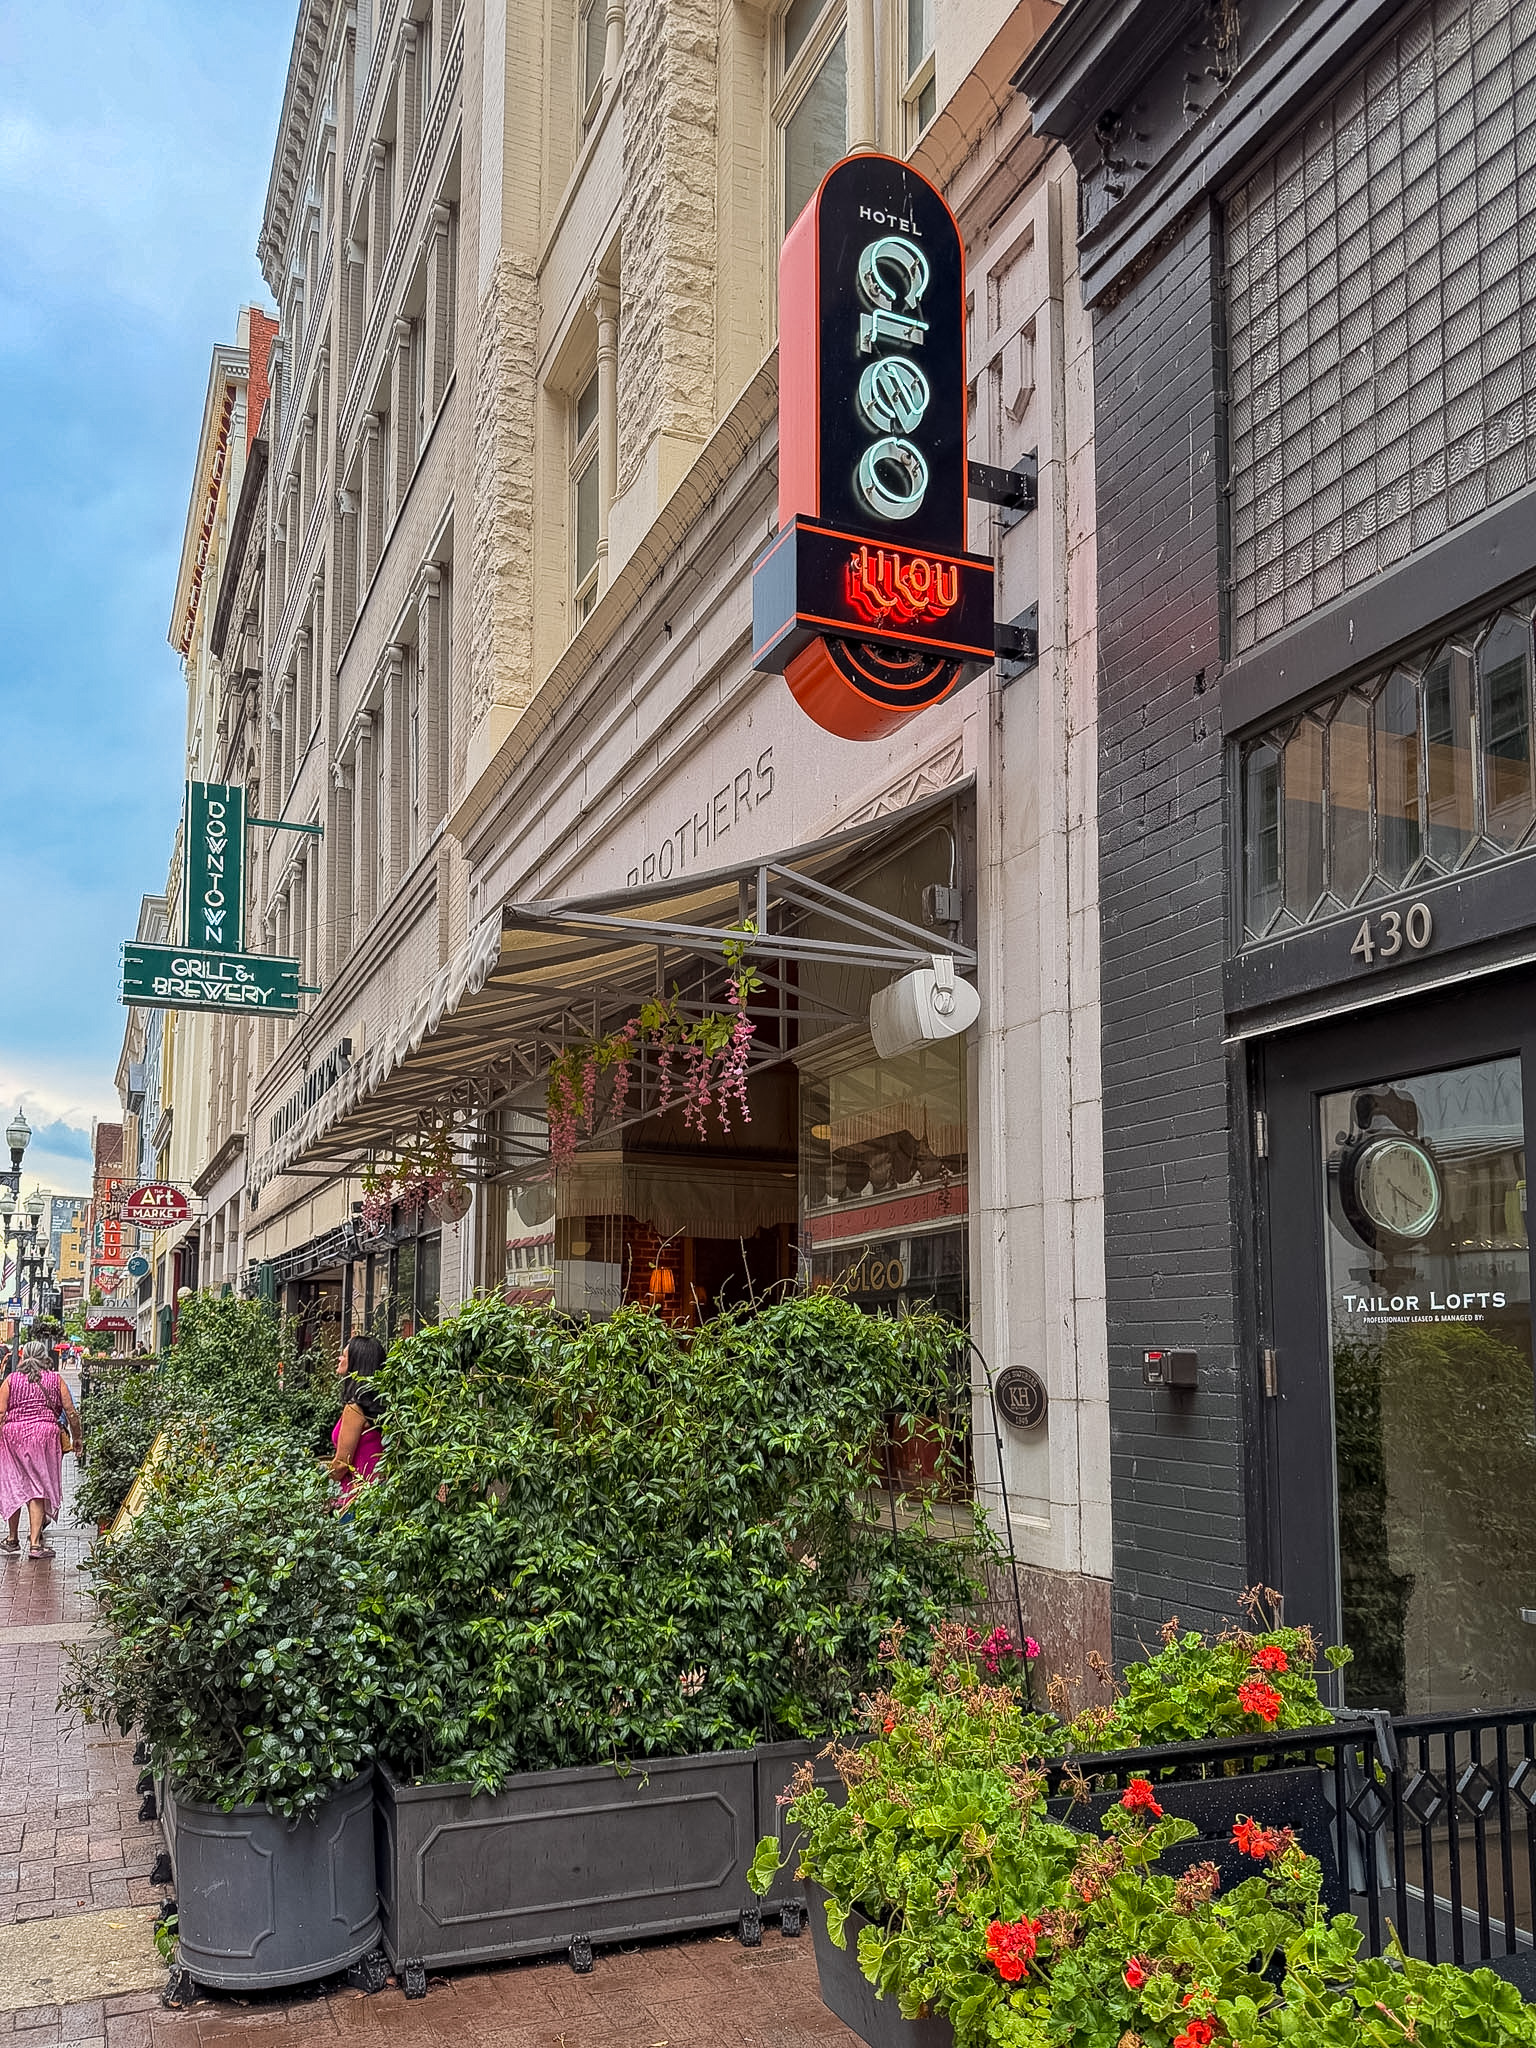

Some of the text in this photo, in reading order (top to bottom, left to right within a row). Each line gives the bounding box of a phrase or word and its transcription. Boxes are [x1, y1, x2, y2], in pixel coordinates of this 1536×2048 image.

[859, 205, 922, 236] HOTEL
[203, 801, 228, 943] DOWNTOWN
[1350, 902, 1433, 963] 430
[171, 958, 233, 981] GRILL
[152, 977, 275, 1004] BREWERY
[140, 1188, 174, 1206] Art
[133, 1208, 181, 1218] MARKET
[1342, 1291, 1507, 1313] TAILOR LOFTS
[1363, 1313, 1485, 1324] PROFESSIONALLY LEASED & MANAGED BY:
[1009, 1386, 1030, 1407] KH
